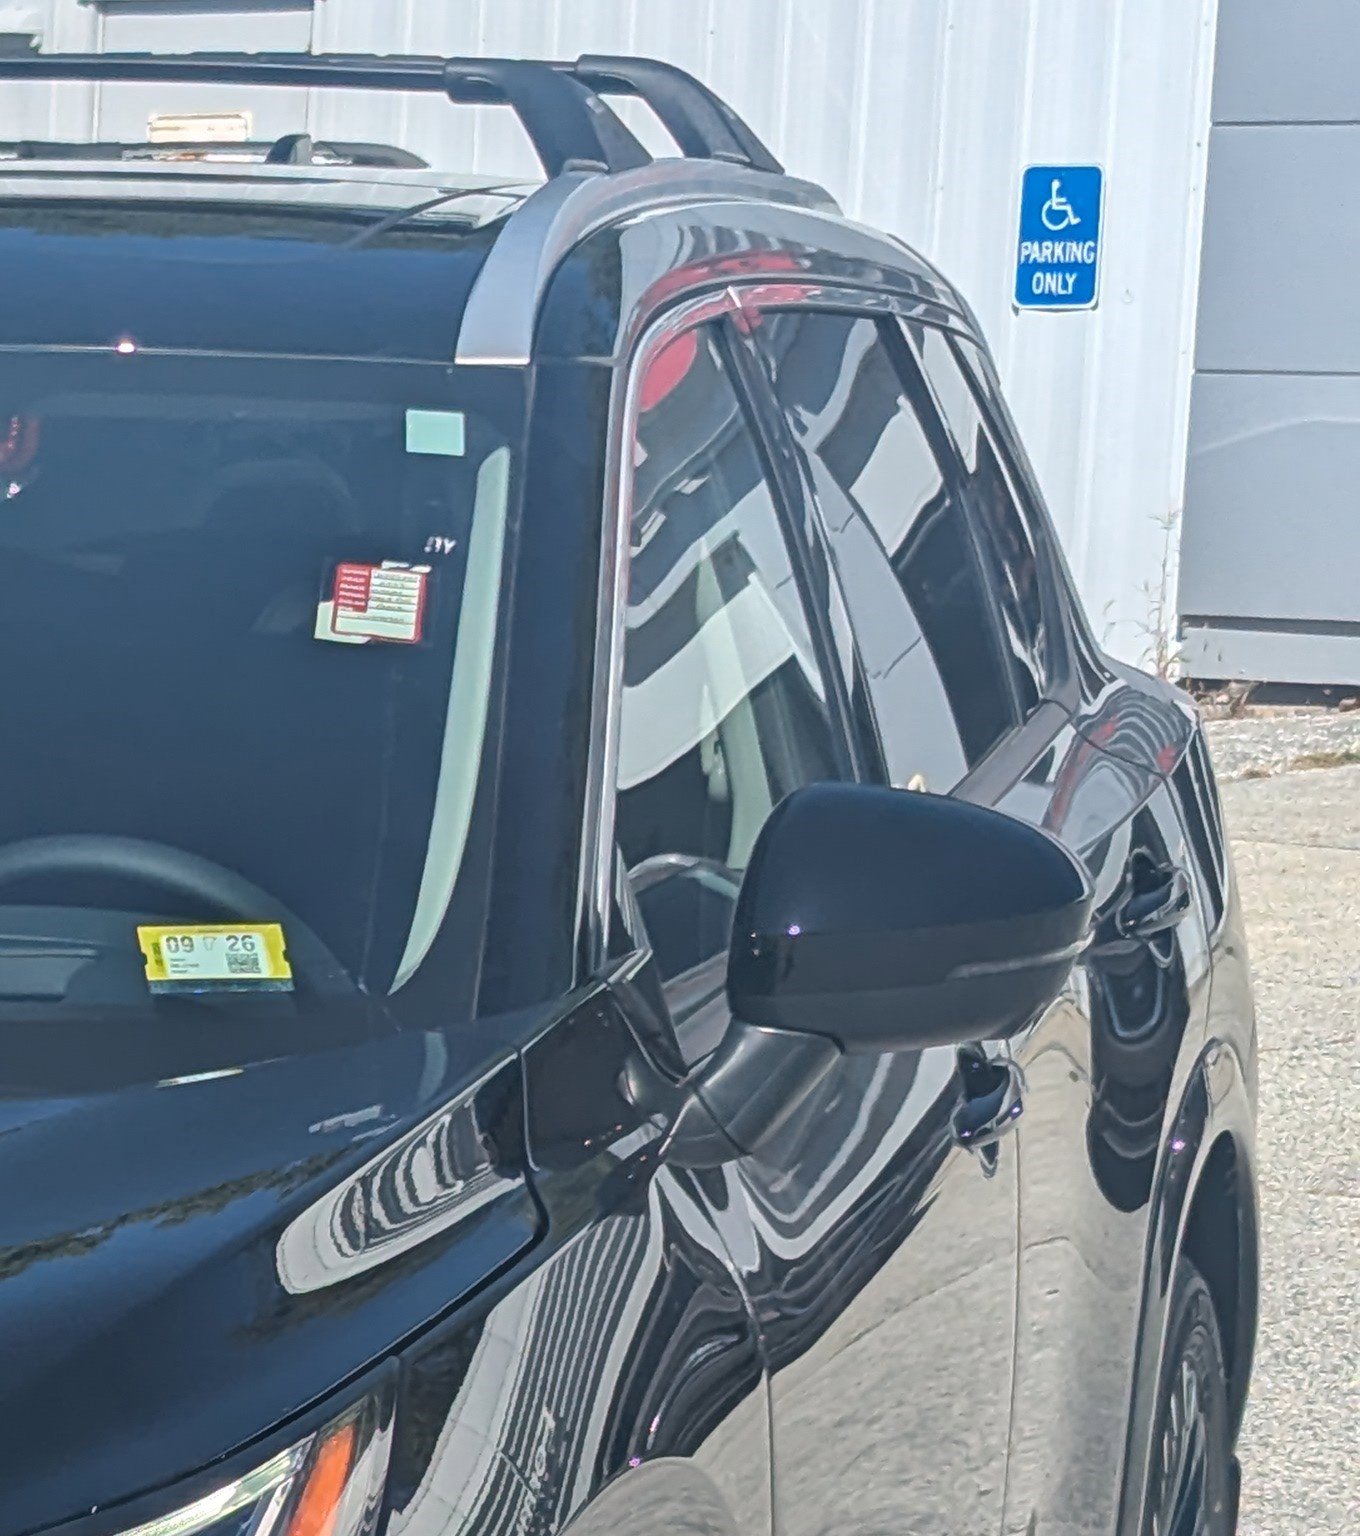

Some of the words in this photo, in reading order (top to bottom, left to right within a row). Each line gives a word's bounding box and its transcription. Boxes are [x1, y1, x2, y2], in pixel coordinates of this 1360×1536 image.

[1020, 240, 1096, 265] PARKING
[1031, 271, 1077, 295] ONLY
[165, 935, 195, 954] 09
[225, 934, 256, 952] 26
